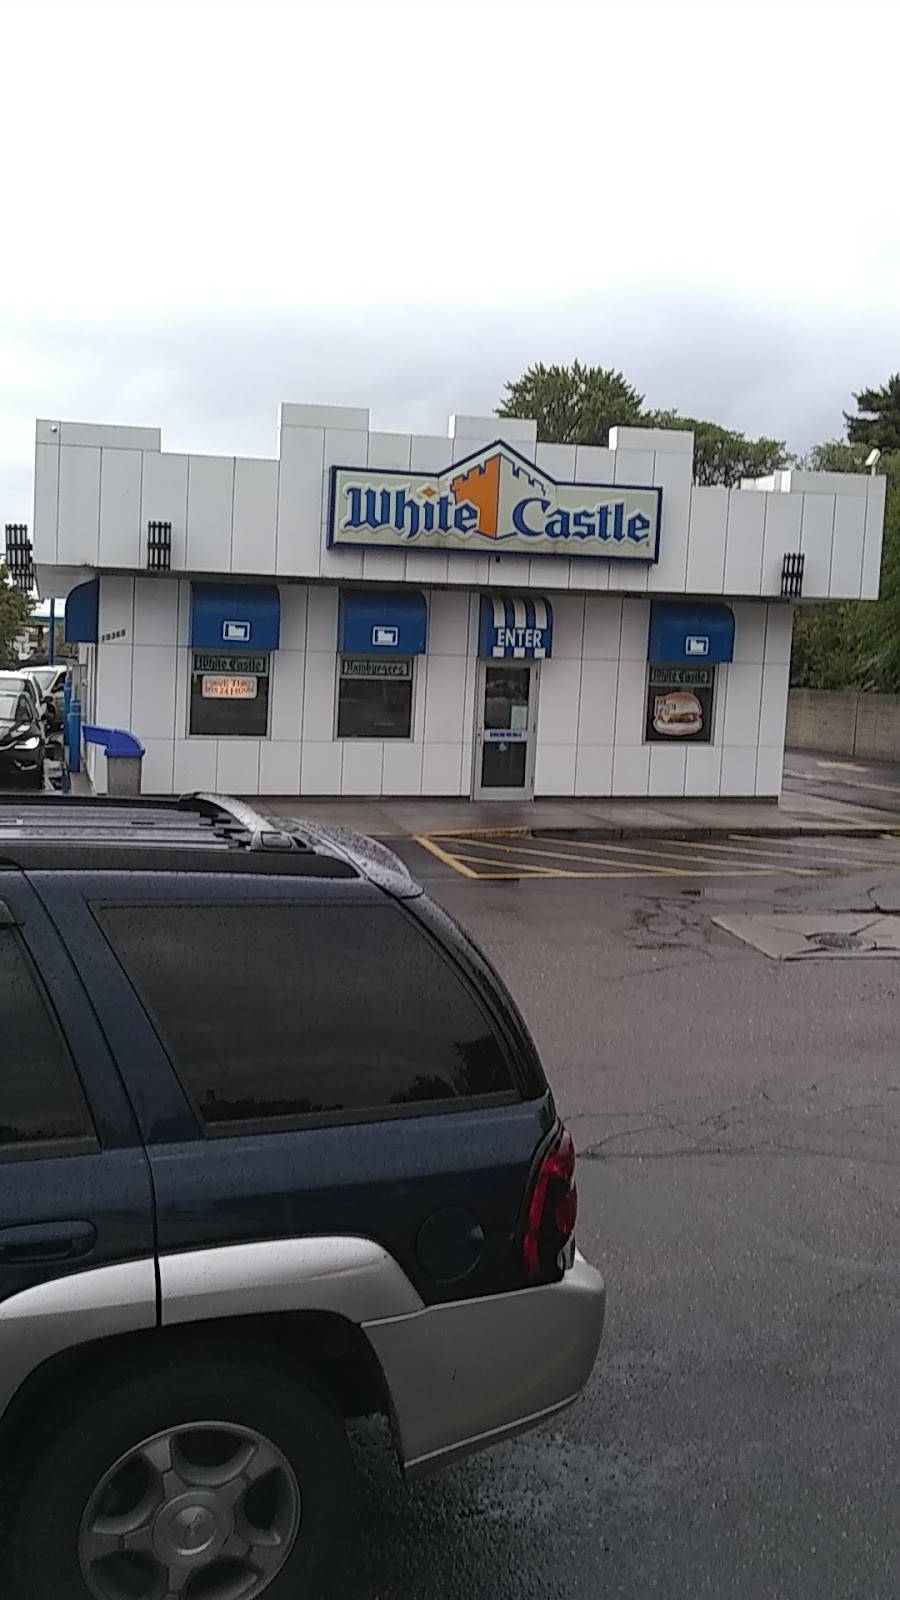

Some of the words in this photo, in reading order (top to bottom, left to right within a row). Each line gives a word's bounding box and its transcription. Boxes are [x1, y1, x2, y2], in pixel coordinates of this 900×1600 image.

[343, 487, 478, 539] White
[512, 497, 650, 541] Castle
[497, 628, 542, 647] ENTER
[345, 660, 404, 675] Hamburgers
